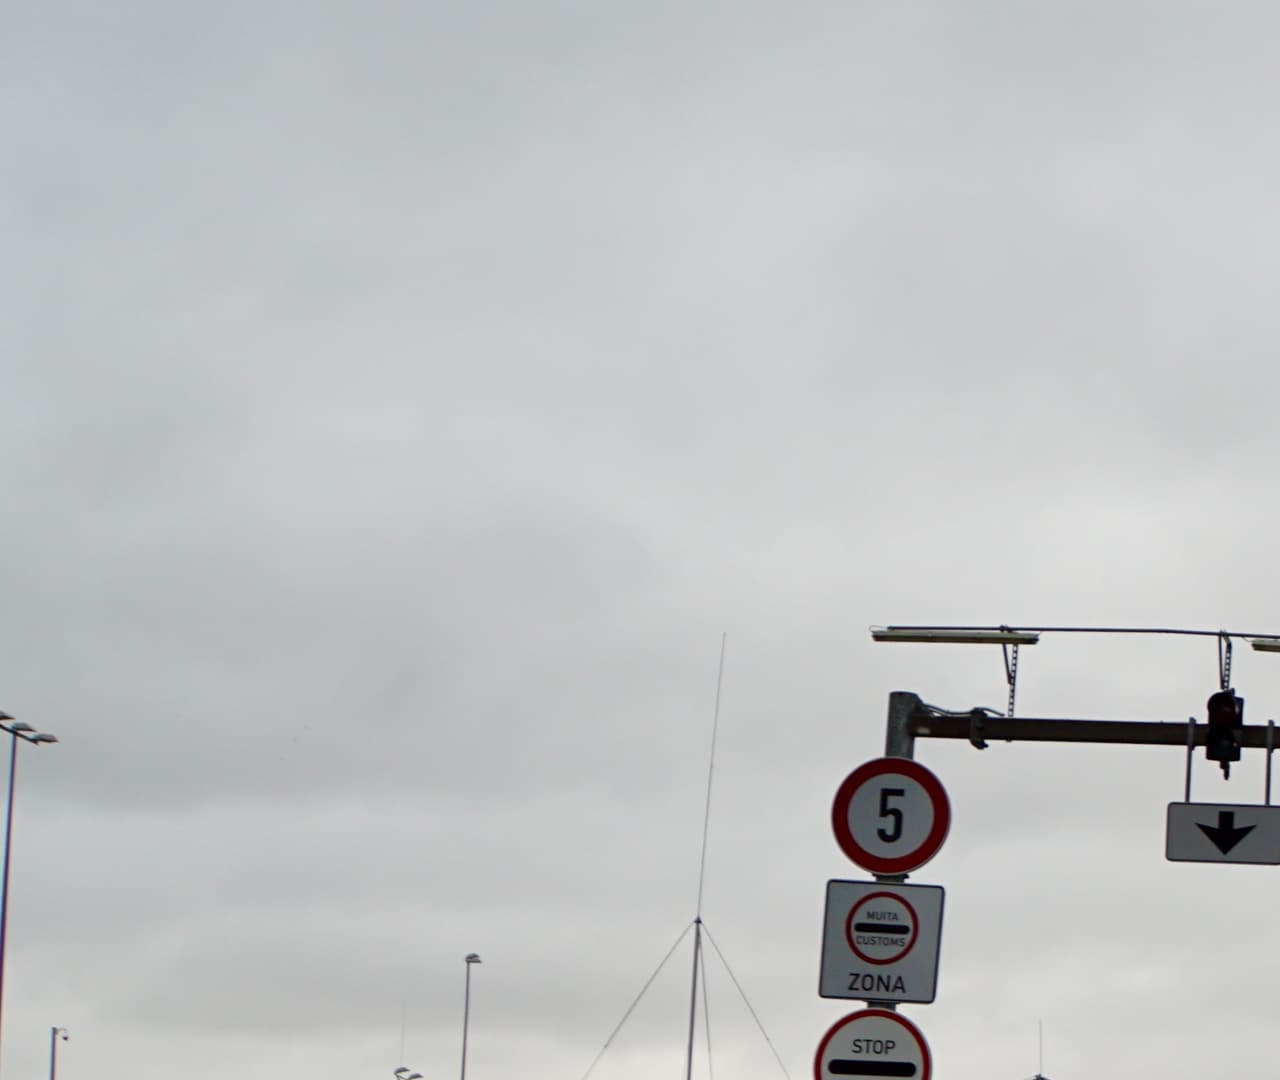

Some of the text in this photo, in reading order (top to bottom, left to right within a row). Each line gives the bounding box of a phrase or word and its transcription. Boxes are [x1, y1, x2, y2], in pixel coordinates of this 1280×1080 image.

[876, 787, 905, 843] 5
[866, 911, 898, 921] MUITA
[856, 935, 906, 947] CUSTOMS
[848, 973, 906, 994] ZONA
[852, 1038, 896, 1055] STOP
